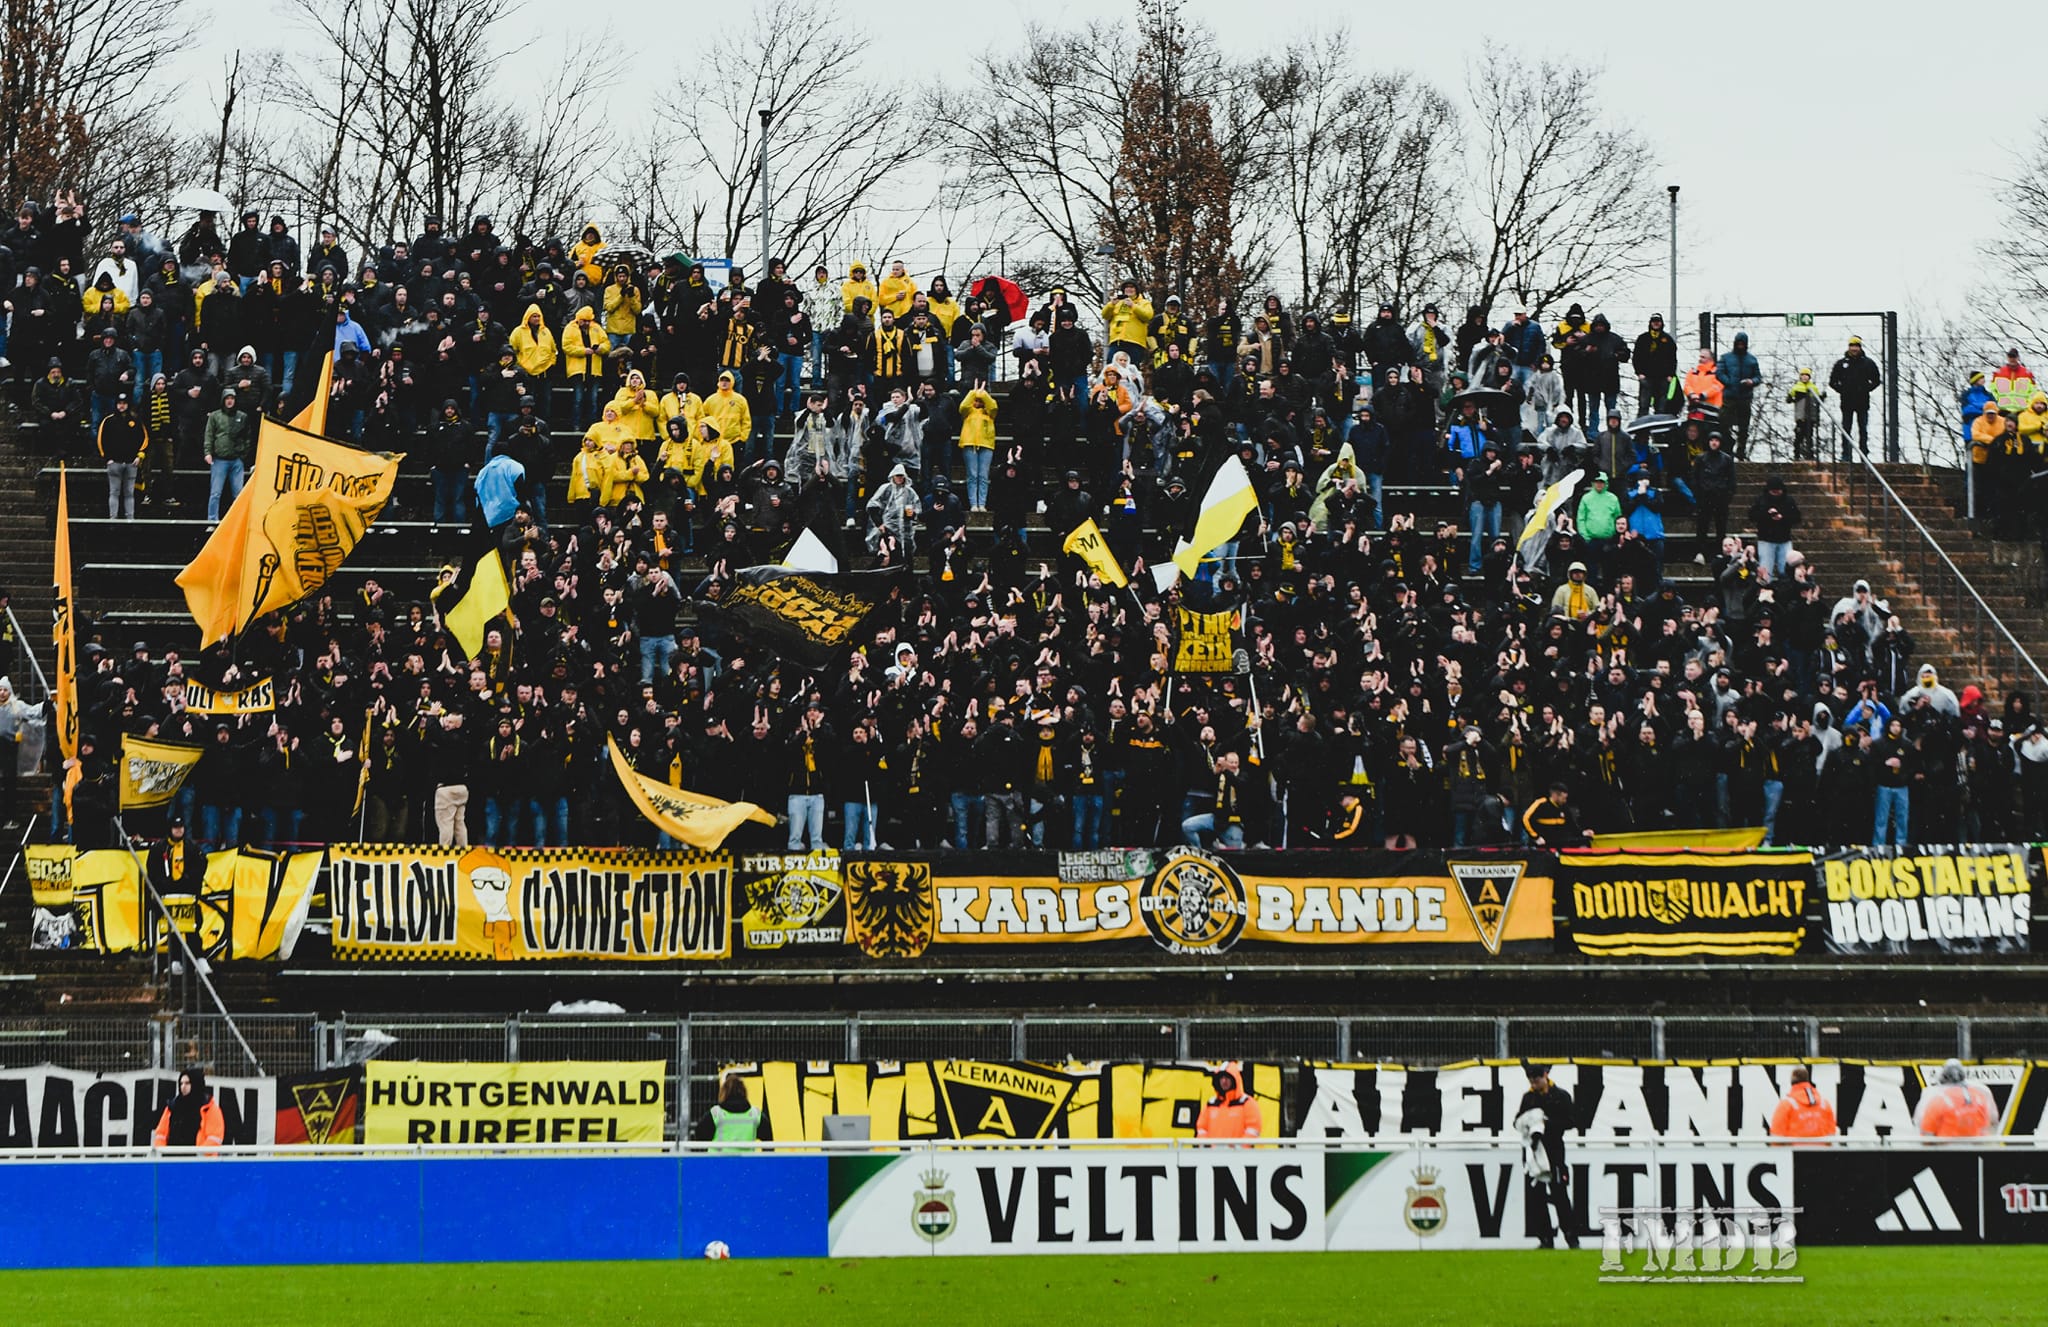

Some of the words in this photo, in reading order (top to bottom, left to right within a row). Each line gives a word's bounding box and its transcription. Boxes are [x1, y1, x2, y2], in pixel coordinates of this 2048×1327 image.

[1177, 640, 1233, 660] KEIN
[187, 685, 216, 709] ULT
[238, 680, 273, 709] RAS
[29, 858, 71, 880] 50+1
[743, 853, 781, 872] FÜR
[784, 855, 841, 871] STADT
[1459, 867, 1517, 875] ALEMANNIA
[1824, 853, 2032, 901] BOXSTAFFEL
[333, 857, 458, 945] YELLOW
[520, 866, 728, 955] CONNECTION
[1140, 896, 1173, 912] ULT
[1213, 898, 1247, 915] RAS
[1478, 880, 1501, 903] A
[1573, 880, 1650, 919] DOM
[1690, 878, 1806, 919] WACHT
[937, 884, 1132, 935] KARLS
[1256, 885, 1447, 933] BANDE
[1827, 893, 2031, 944] HOOLIGANS
[750, 930, 784, 945] UND
[371, 1075, 660, 1107] HÜRTGENWALD
[943, 1062, 1057, 1098] ALEMANNIA
[0, 1076, 259, 1147] AACHN
[977, 1095, 1017, 1137] A
[407, 1117, 629, 1144] RUREIFEL
[975, 1165, 1308, 1244] VELTINS
